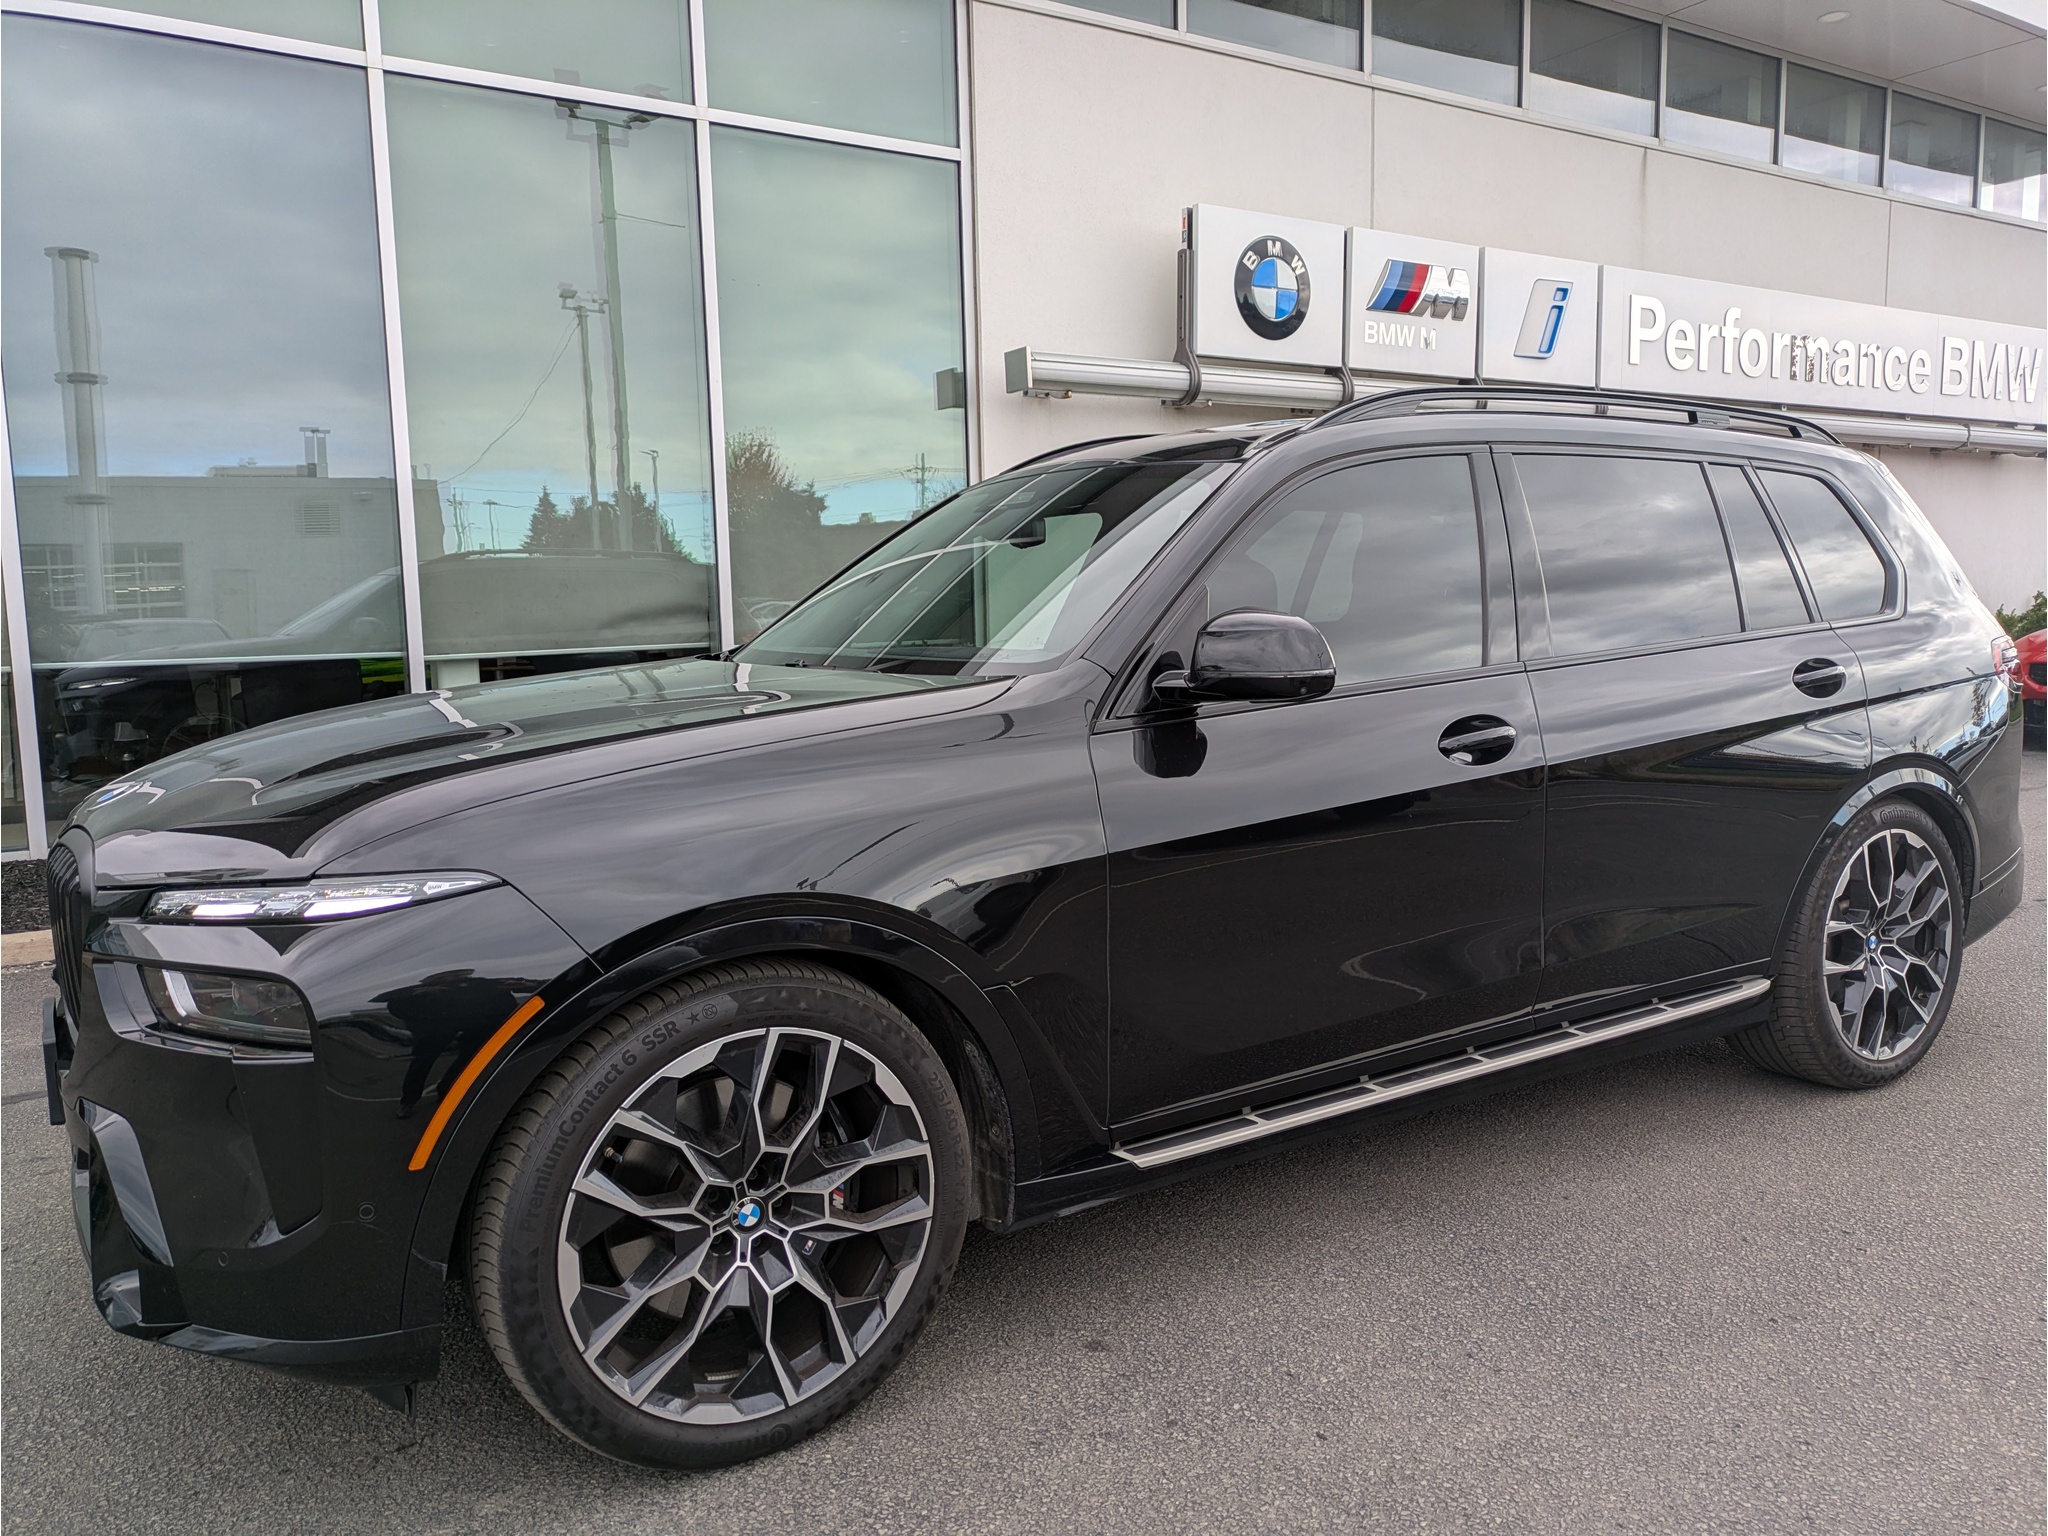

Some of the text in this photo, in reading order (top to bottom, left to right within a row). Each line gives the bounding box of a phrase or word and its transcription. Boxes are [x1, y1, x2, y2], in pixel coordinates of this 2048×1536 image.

[1242, 239, 1306, 275] BMW
[1364, 320, 1438, 350] BMW M
[1628, 293, 2044, 404] Performance BMW
[1879, 806, 1922, 825] Continental
[519, 1063, 625, 1233] PremiumContact
[620, 1049, 638, 1067] 6
[641, 1020, 682, 1053] SSR
[732, 1198, 751, 1226] BMW
